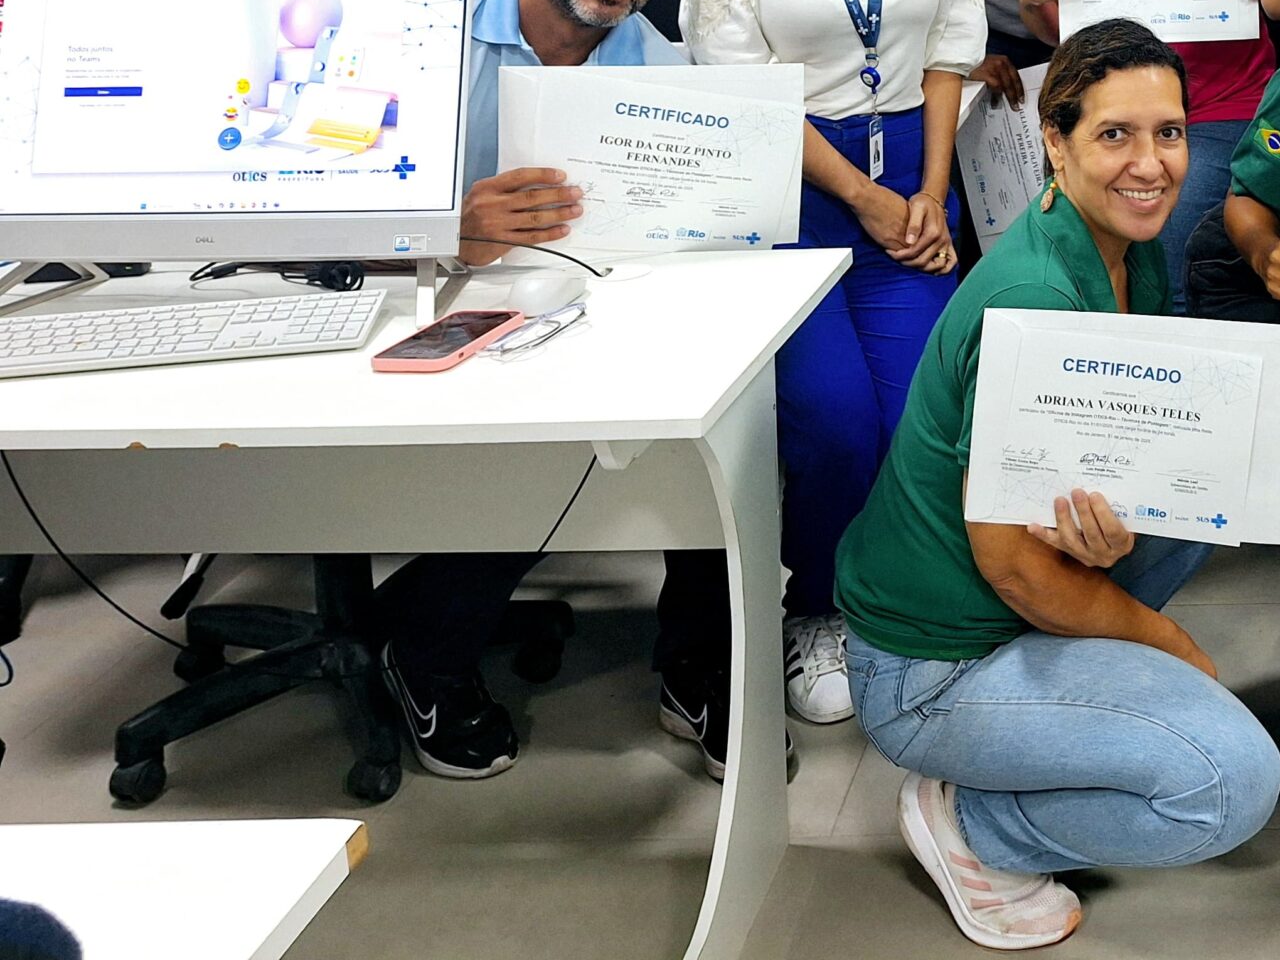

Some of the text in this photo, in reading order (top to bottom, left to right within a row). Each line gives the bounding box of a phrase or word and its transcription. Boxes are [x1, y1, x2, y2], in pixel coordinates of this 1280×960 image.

[1177, 13, 1191, 21] Rio
[615, 102, 729, 129] CERTIFICADO
[599, 135, 732, 159] IGOR DA CRUZ PINTO
[1015, 133, 1029, 166] PEREIRA
[1025, 139, 1034, 152] DE
[626, 151, 701, 168] FERNANDES
[232, 169, 267, 182] otics
[1028, 151, 1043, 187] OLIVEIRA
[687, 229, 706, 238] Rio
[1062, 357, 1182, 384] CERTIFICADO
[1033, 393, 1201, 423] ADRIANA VASQUES TELES
[1148, 506, 1167, 518] Rio
[1196, 515, 1210, 523] SUS
